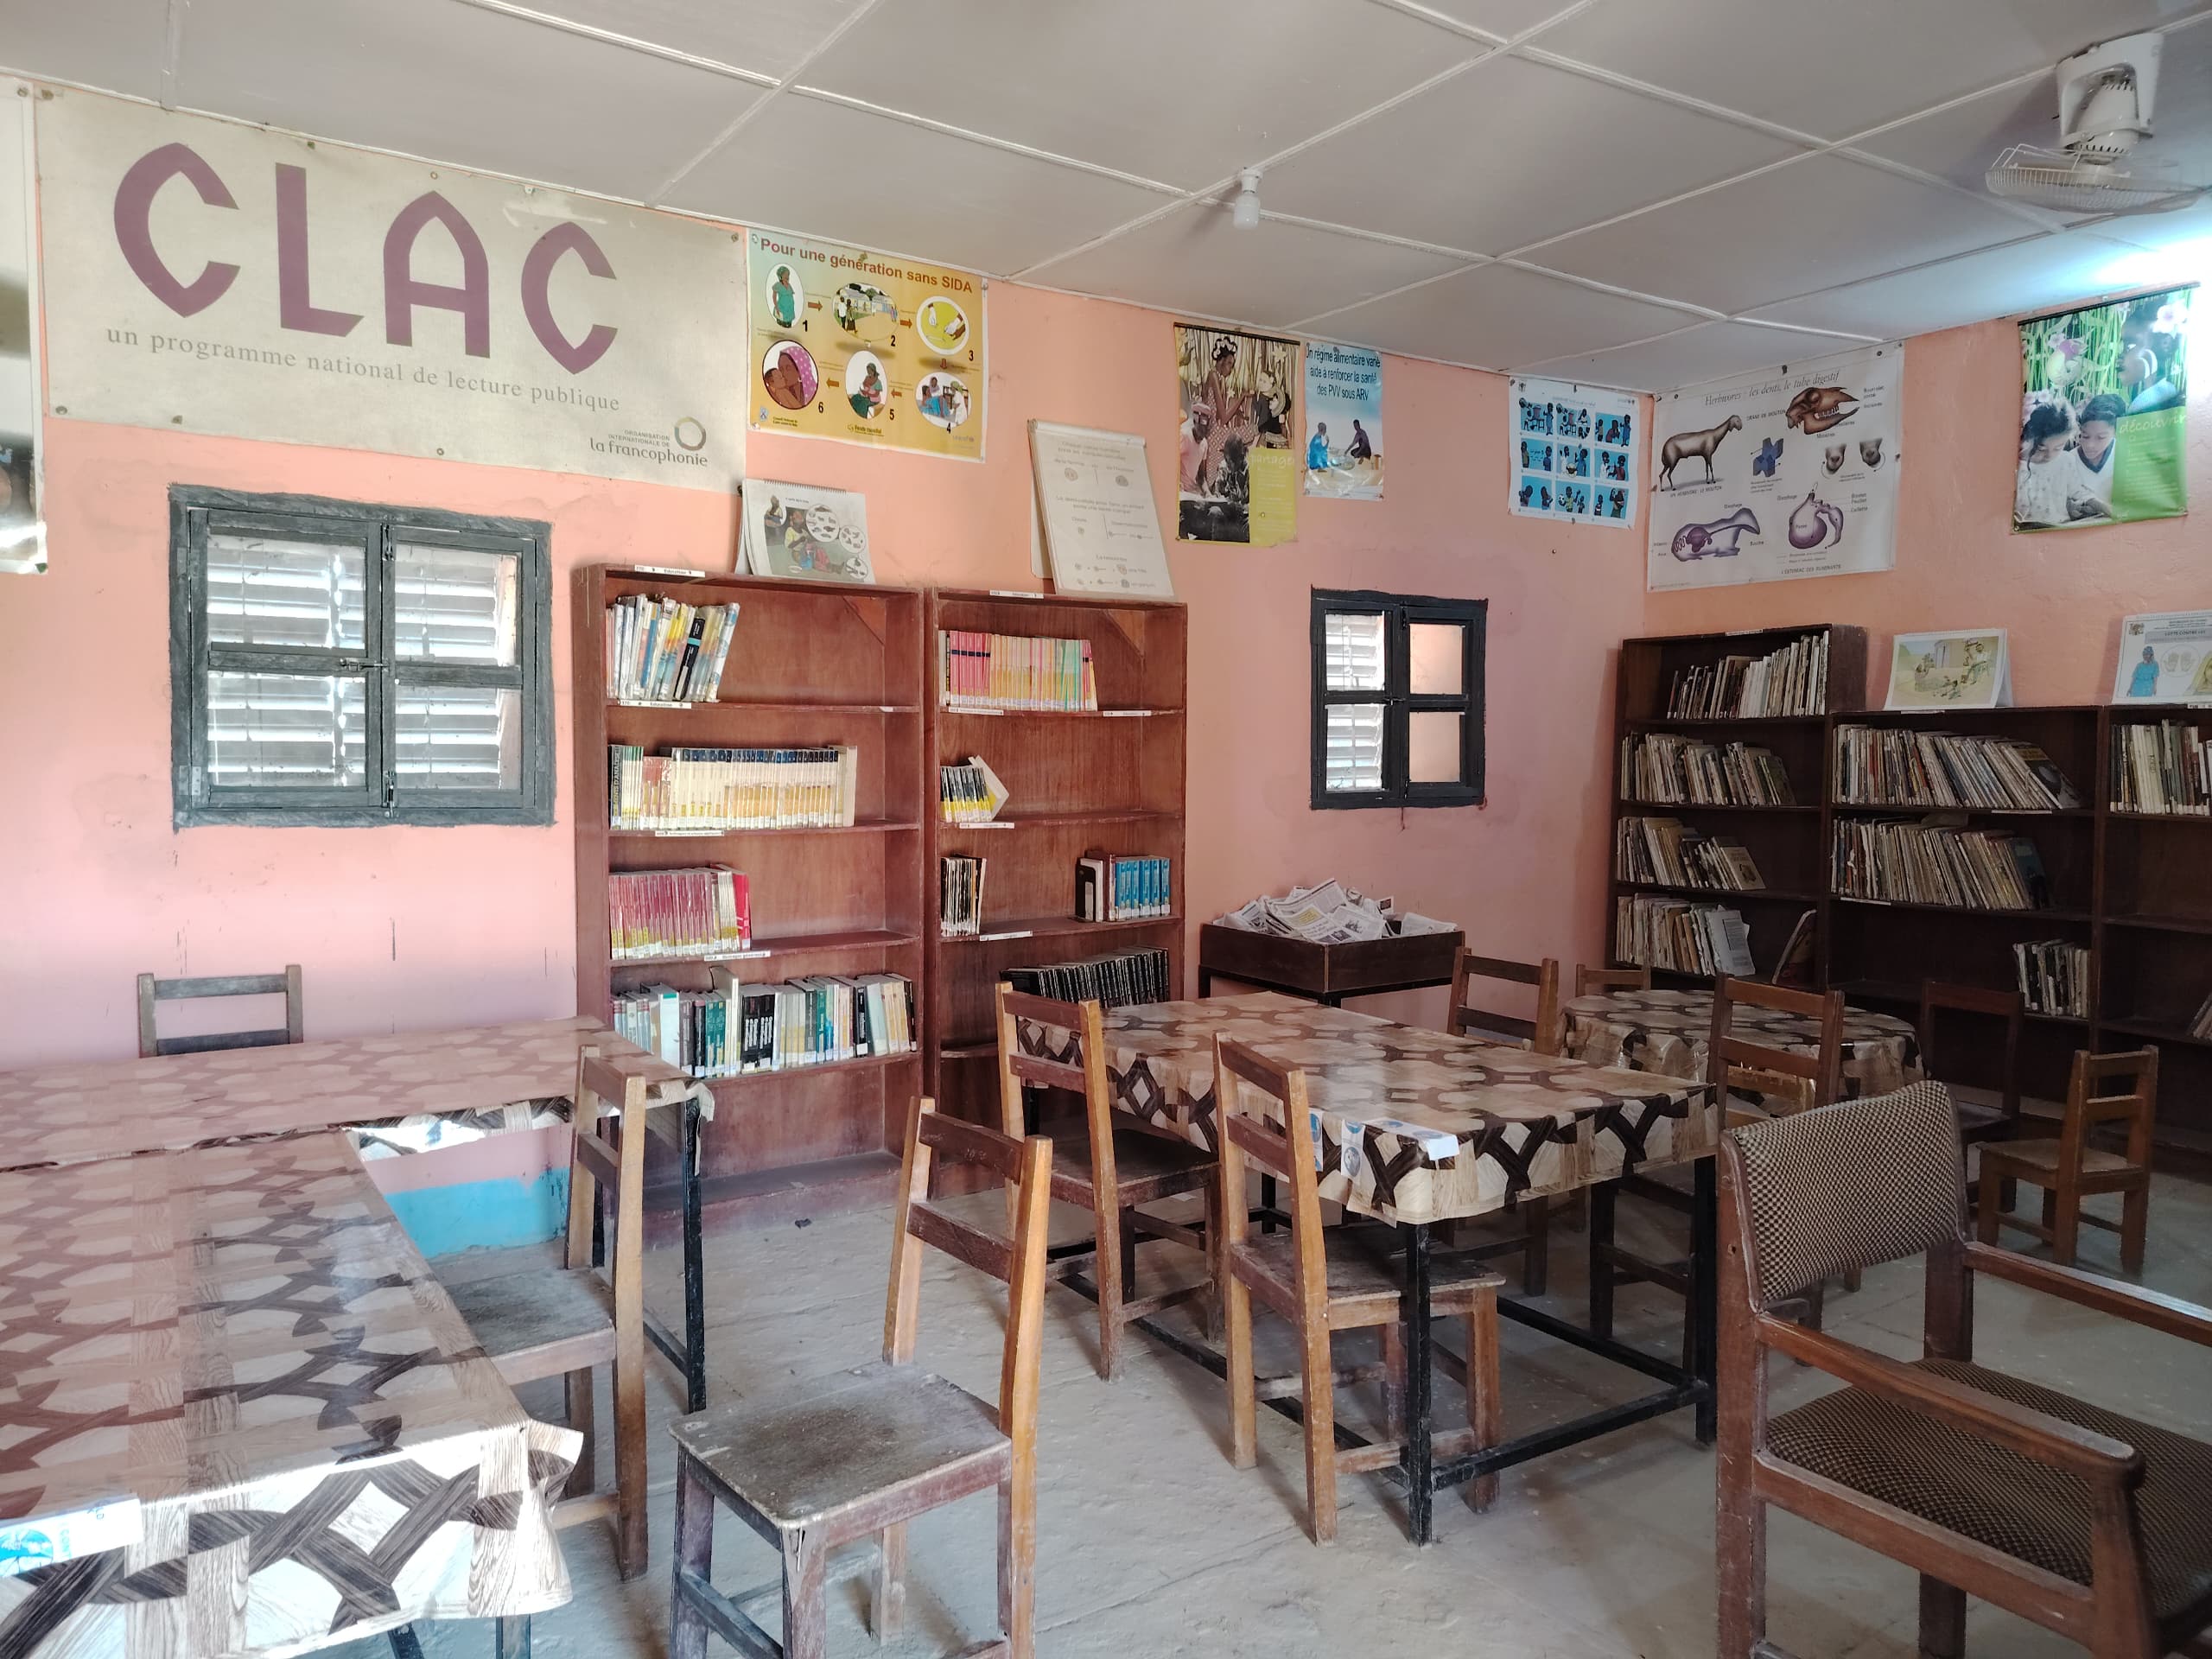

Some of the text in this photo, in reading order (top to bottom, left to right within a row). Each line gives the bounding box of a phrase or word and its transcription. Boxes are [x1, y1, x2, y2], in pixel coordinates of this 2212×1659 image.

[113, 142, 619, 375] CLAC
[760, 238, 973, 294] Pour une génération sans SIDA
[802, 319, 808, 333] 1
[890, 334, 896, 347] 2
[968, 350, 975, 361] 3
[1333, 351, 1365, 366] alimentaire
[105, 327, 620, 412] un programme national de lecture publique
[1310, 365, 1322, 378] aide
[1327, 368, 1353, 382] renforcer
[1353, 371, 1360, 383] la
[1317, 383, 1327, 396] des
[1341, 388, 1355, 400] sous
[1356, 388, 1370, 401] ARV
[1704, 391, 1742, 406] Herbivores
[1749, 386, 1760, 397] les
[1784, 379, 1792, 390] le
[1794, 375, 1811, 389] tube
[1812, 371, 1840, 387] digestif
[817, 401, 824, 414] 6
[889, 409, 895, 421] 5
[946, 422, 952, 434] 4
[589, 437, 709, 467] la francophonie
